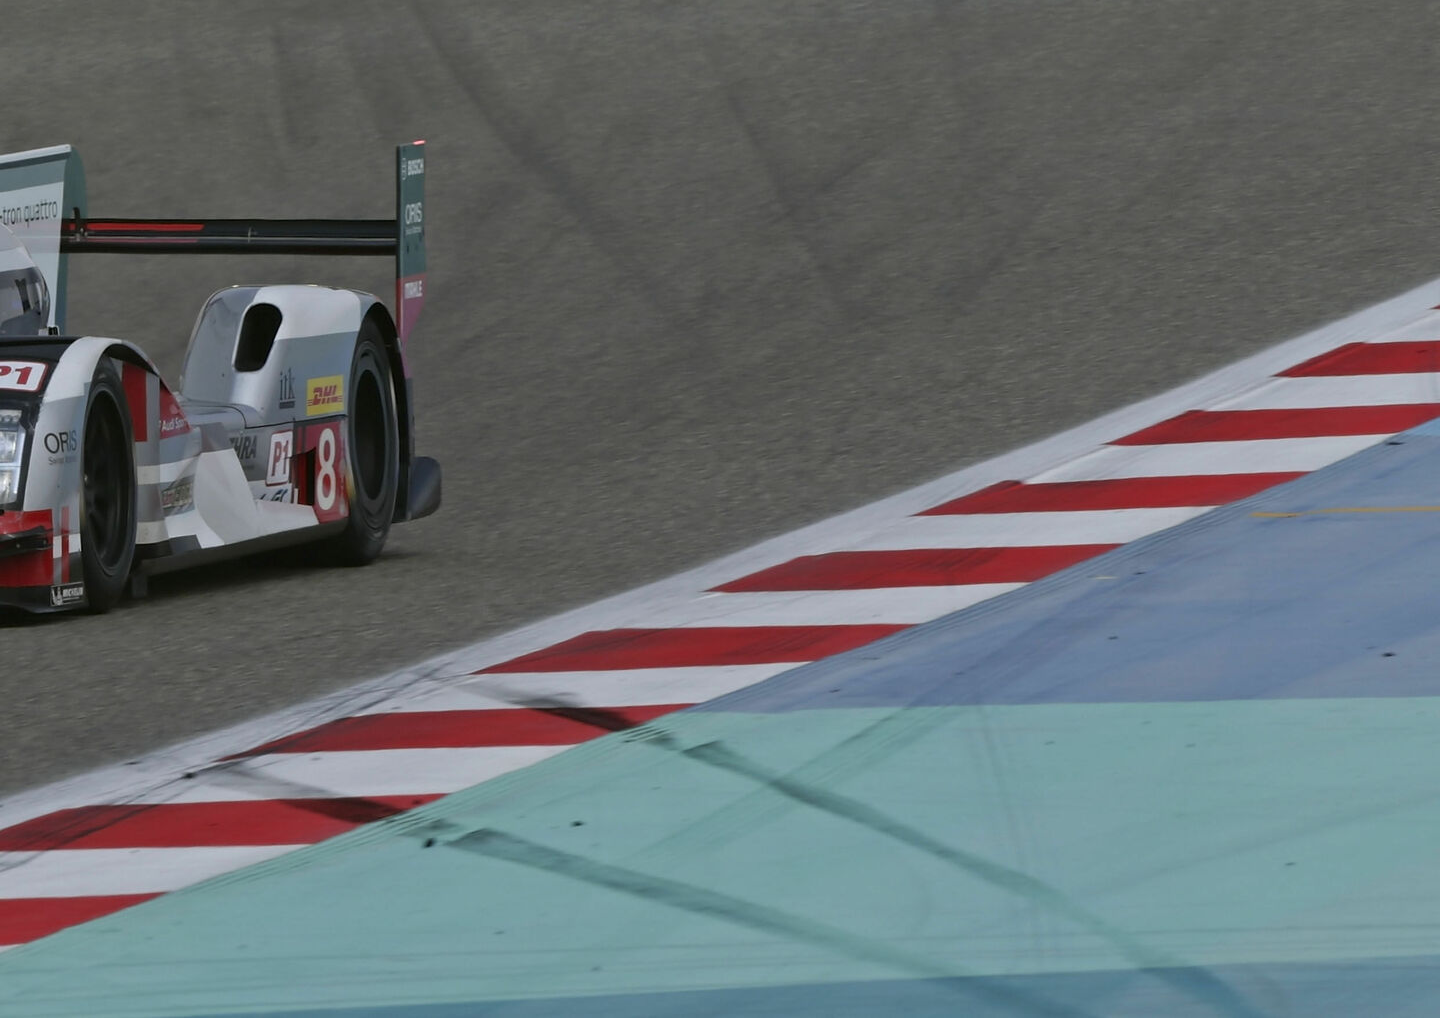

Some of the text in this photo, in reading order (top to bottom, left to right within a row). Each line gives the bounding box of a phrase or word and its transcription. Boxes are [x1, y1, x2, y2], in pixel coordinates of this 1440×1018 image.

[23, 198, 58, 228] quattro
[44, 430, 77, 454] ORIS
[271, 439, 289, 477] P1
[317, 428, 336, 510] 8
